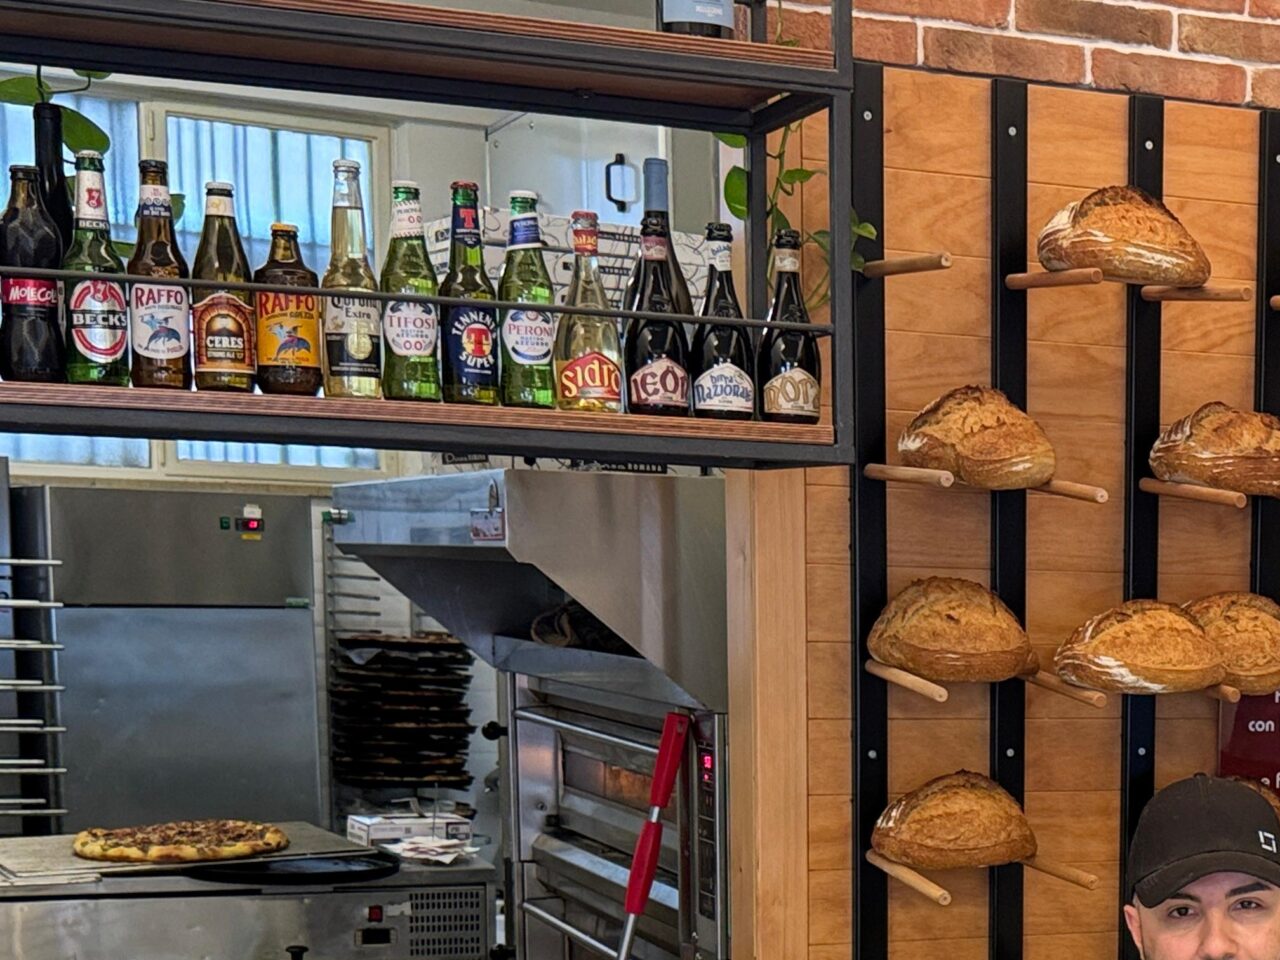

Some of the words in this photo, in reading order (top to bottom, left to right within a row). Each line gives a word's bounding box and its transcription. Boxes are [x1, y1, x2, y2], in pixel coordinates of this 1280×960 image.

[135, 287, 184, 309] RAFFO
[72, 312, 128, 327] BECK'S
[387, 315, 436, 330] TIFOSI
[206, 335, 244, 349] CERES
[459, 351, 495, 368] SUPER
[1248, 718, 1275, 732] con
